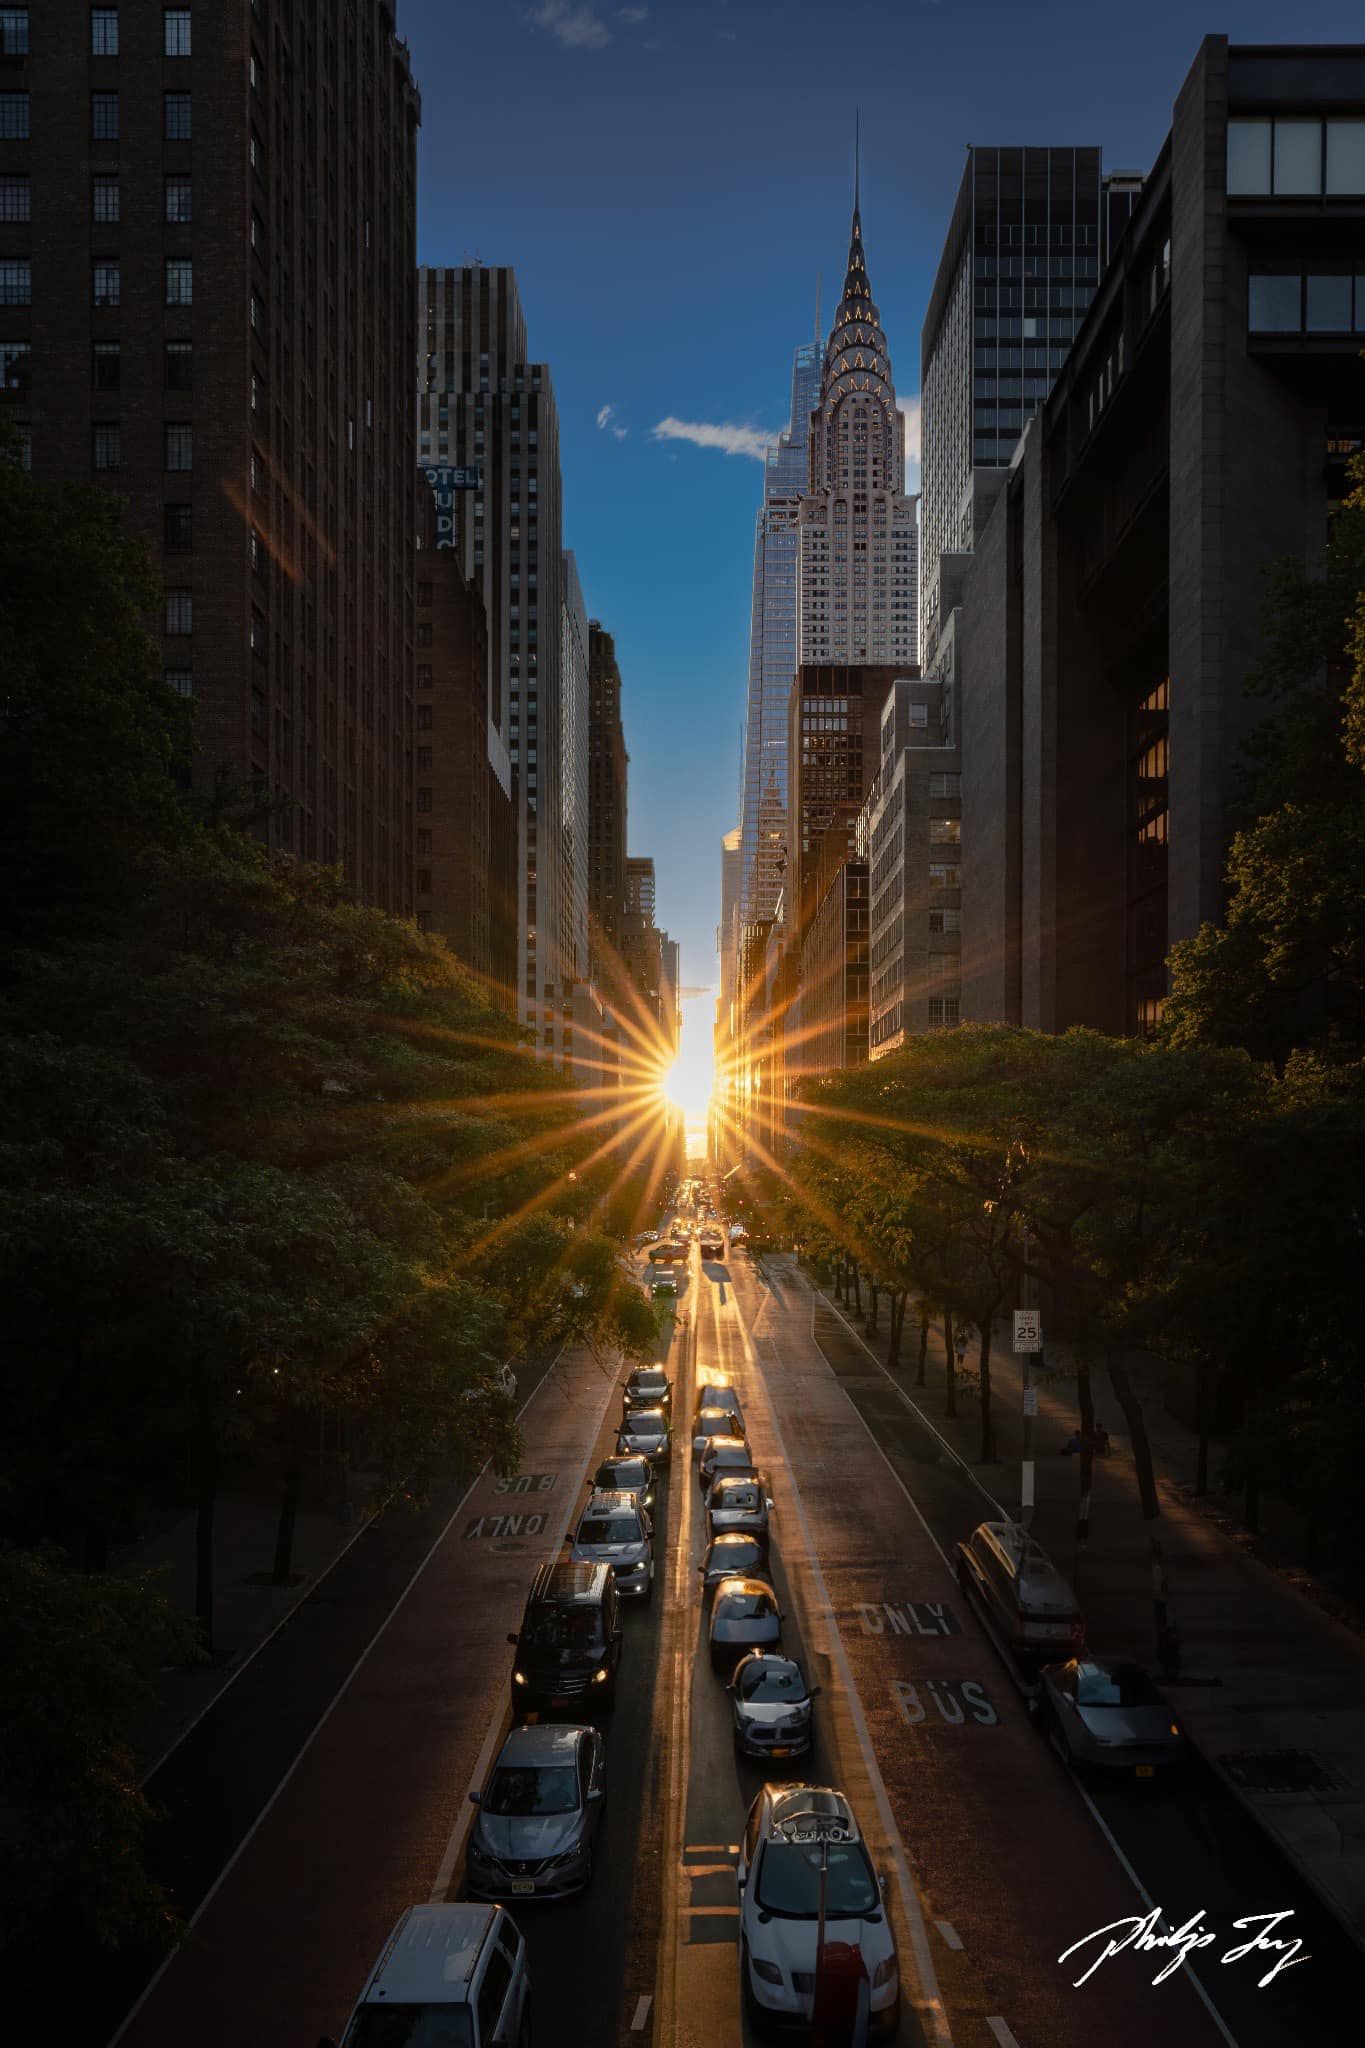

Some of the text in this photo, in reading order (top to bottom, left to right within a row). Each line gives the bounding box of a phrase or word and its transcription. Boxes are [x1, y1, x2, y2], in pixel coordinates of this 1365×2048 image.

[424, 468, 477, 485] OTEL
[1018, 1327, 1036, 1339] 25
[494, 1475, 557, 1495] BUS
[466, 1514, 543, 1538] ONLY
[863, 1602, 951, 1635] ONLY
[894, 1680, 998, 1725] BUS
